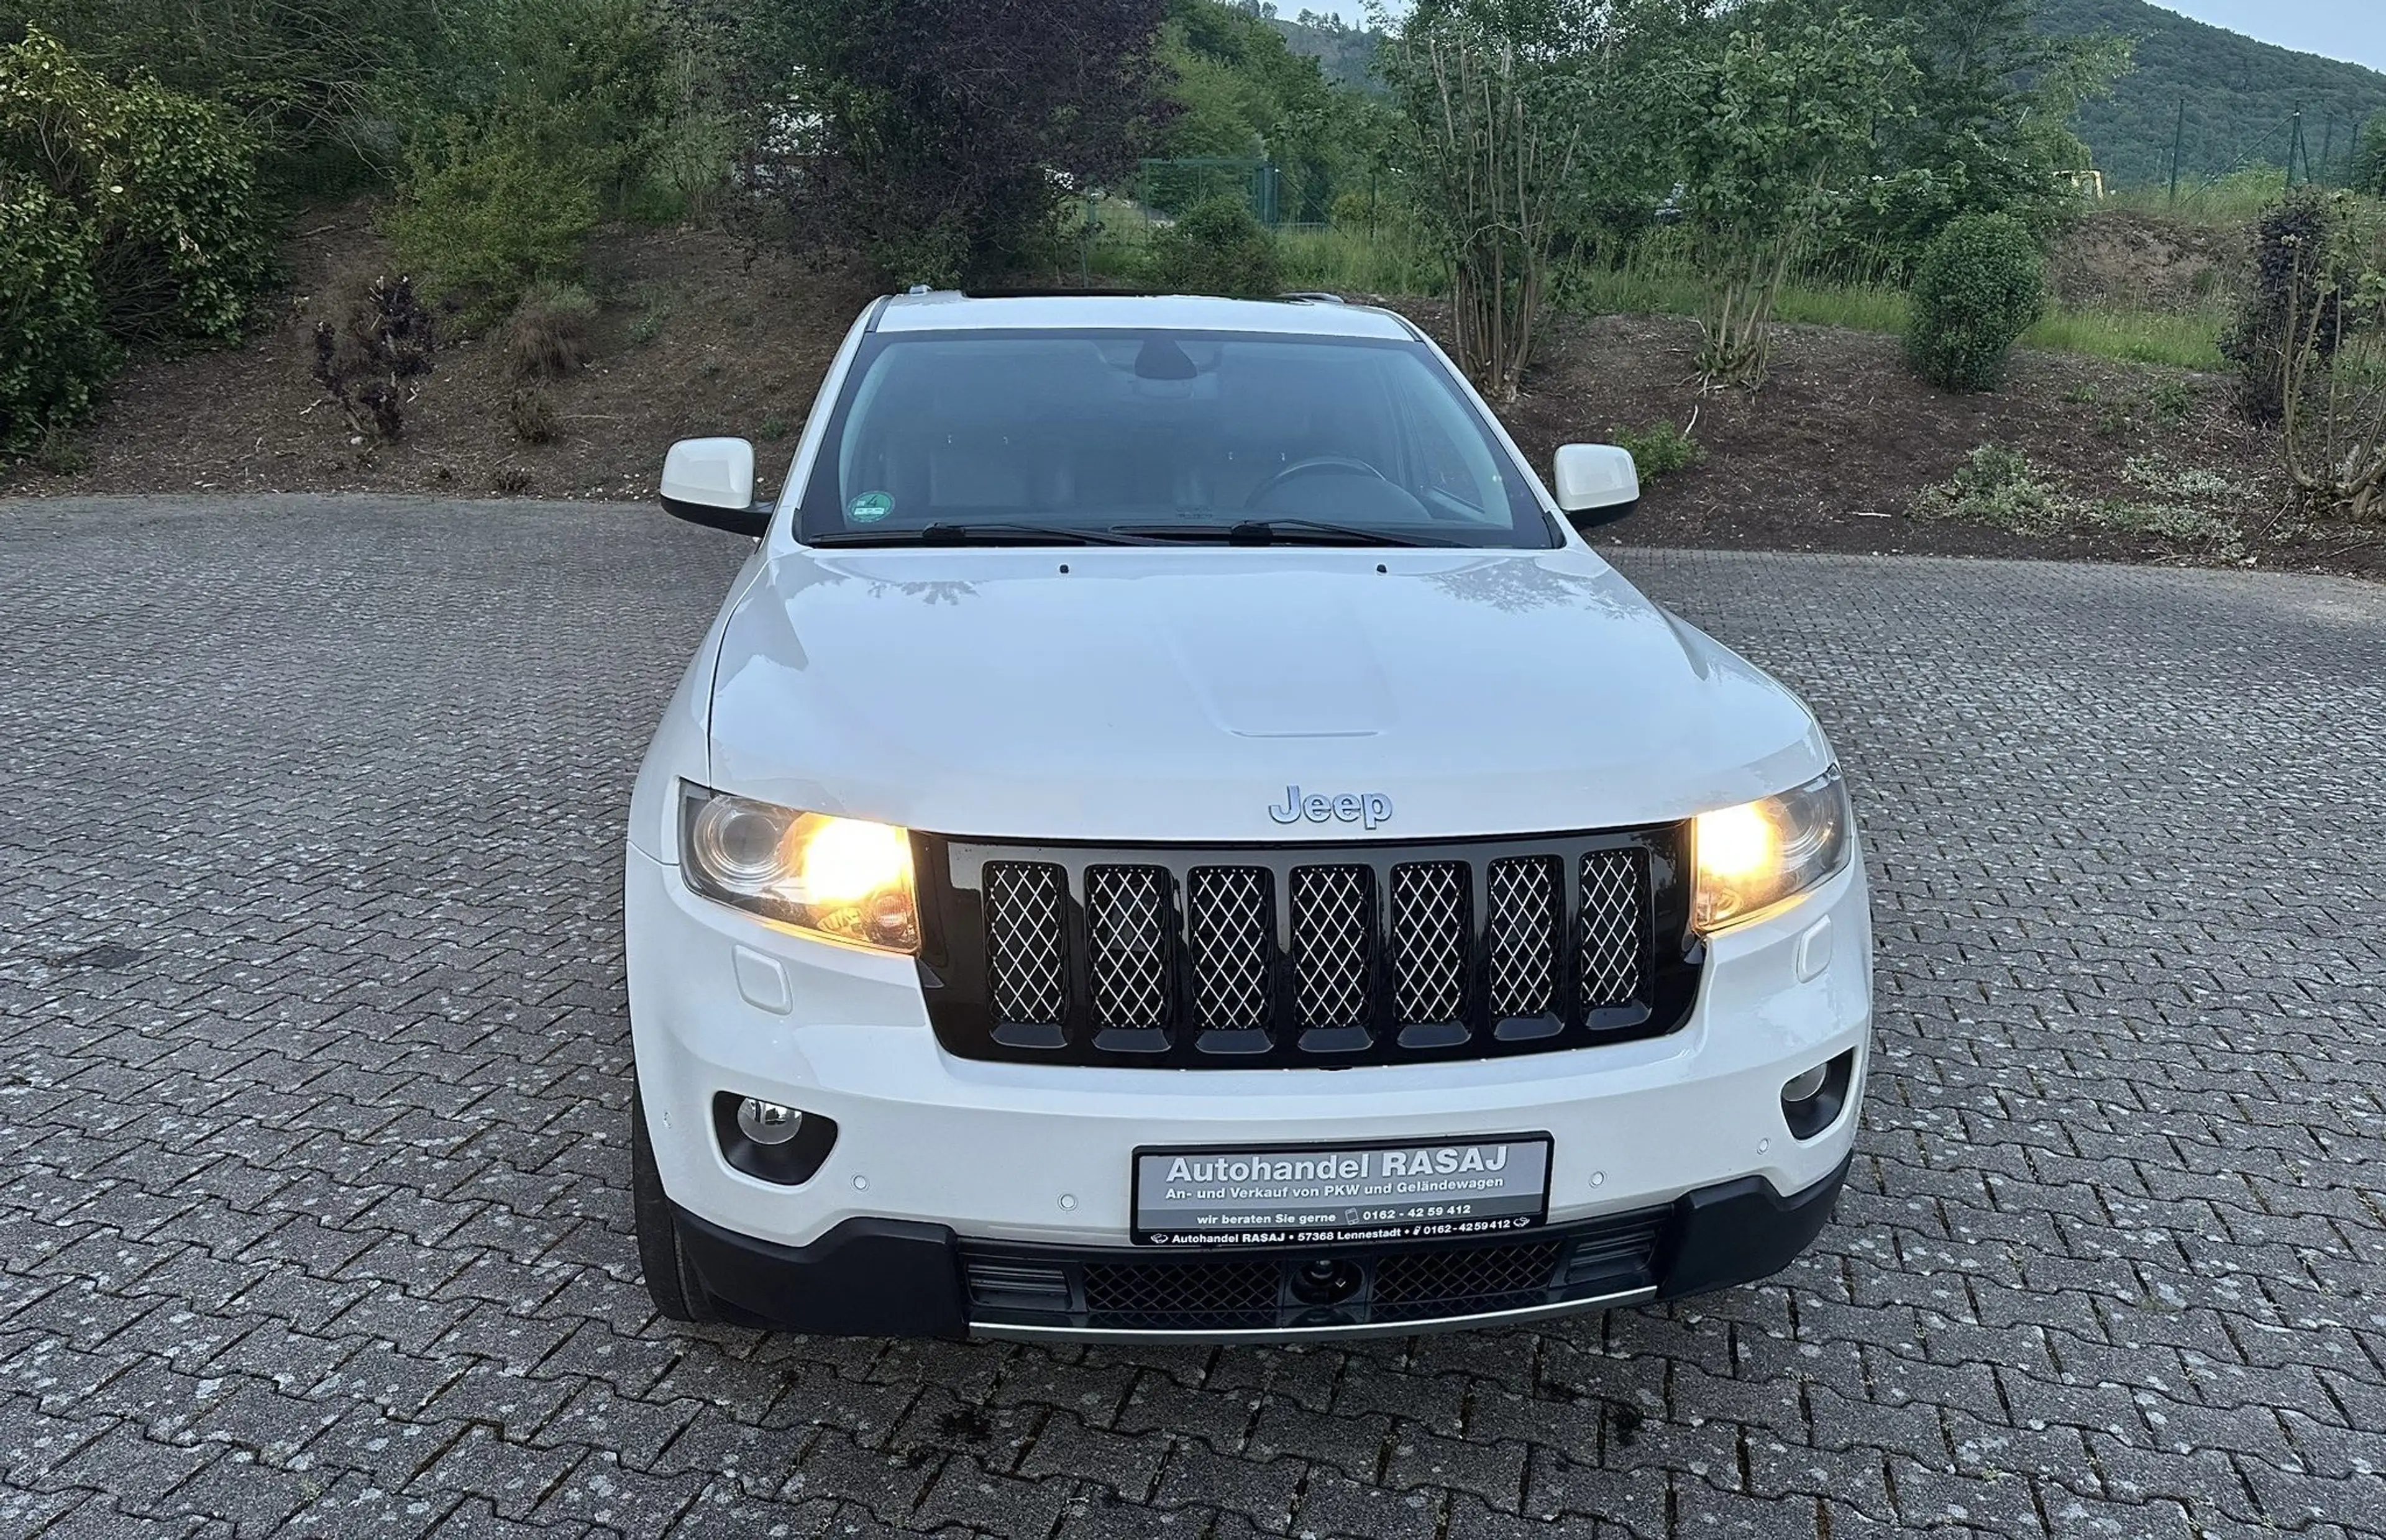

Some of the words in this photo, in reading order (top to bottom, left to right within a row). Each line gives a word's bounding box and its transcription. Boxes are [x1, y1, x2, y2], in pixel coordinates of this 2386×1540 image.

[1268, 785, 1392, 830] Jeep
[1166, 1154, 1369, 1182] Autohandel
[1382, 1146, 1508, 1177] RASAJ
[1166, 1188, 1192, 1199] An-
[1197, 1187, 1225, 1198] und
[1231, 1185, 1288, 1198] Verkauf
[1292, 1187, 1319, 1196] von
[1324, 1185, 1360, 1196] PKW
[1364, 1183, 1392, 1195] und
[1396, 1177, 1504, 1193] Geländewagen
[1197, 1215, 1218, 1224] wir
[1221, 1214, 1271, 1224] beraten
[1275, 1214, 1295, 1224] Sie
[1299, 1213, 1337, 1224] gerne
[1363, 1210, 1396, 1221] 0162
[1447, 1204, 1471, 1216] 412
[1172, 1234, 1239, 1243] Autohandel
[1243, 1232, 1285, 1242] RASAJ
[1297, 1231, 1334, 1241] 57368
[1337, 1229, 1401, 1241] Lennestadt
